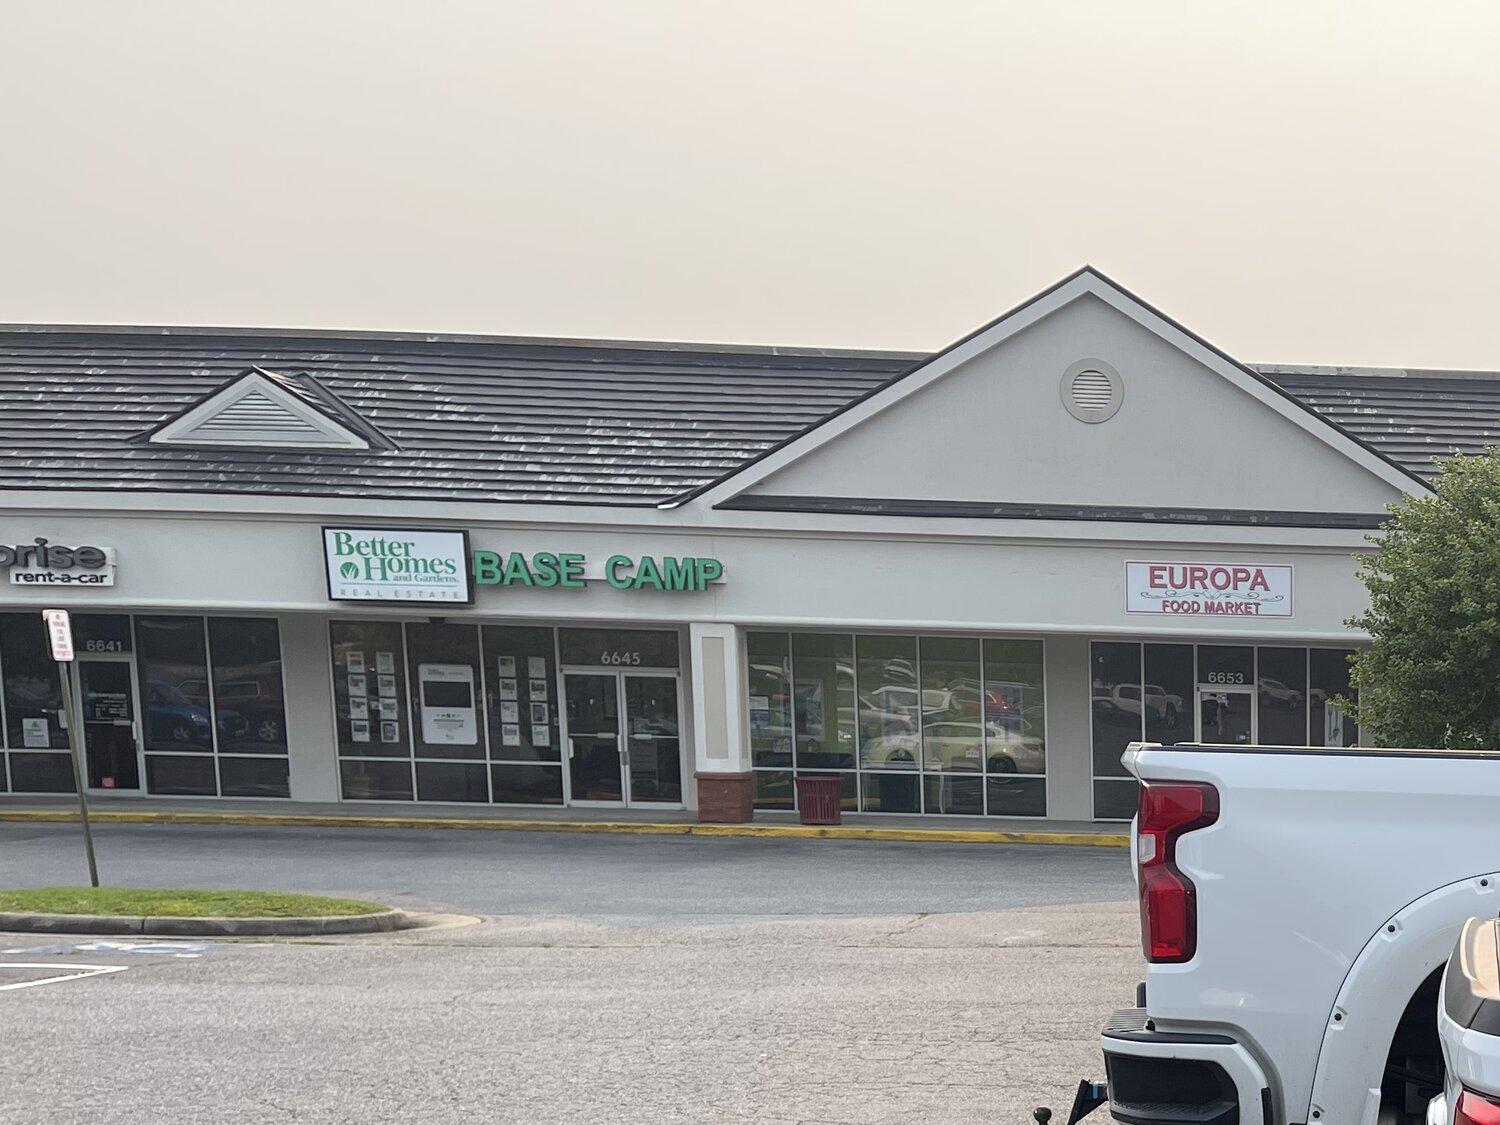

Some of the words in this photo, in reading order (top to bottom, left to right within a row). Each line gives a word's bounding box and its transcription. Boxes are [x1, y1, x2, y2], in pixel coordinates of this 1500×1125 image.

[333, 531, 415, 557] Better
[363, 556, 457, 581] Homes
[473, 551, 587, 588] BASE
[605, 555, 724, 591] CAMP
[15, 571, 107, 583] rent-a-car
[393, 574, 412, 582] and
[1149, 565, 1270, 592] EUROPA
[340, 588, 383, 597] REAL
[394, 590, 458, 599] ESTATE
[1162, 600, 1200, 613] FOOD
[1204, 601, 1261, 615] MARKET
[87, 640, 122, 652] 6641
[601, 651, 641, 665] 6645
[1208, 672, 1244, 684] 6653
